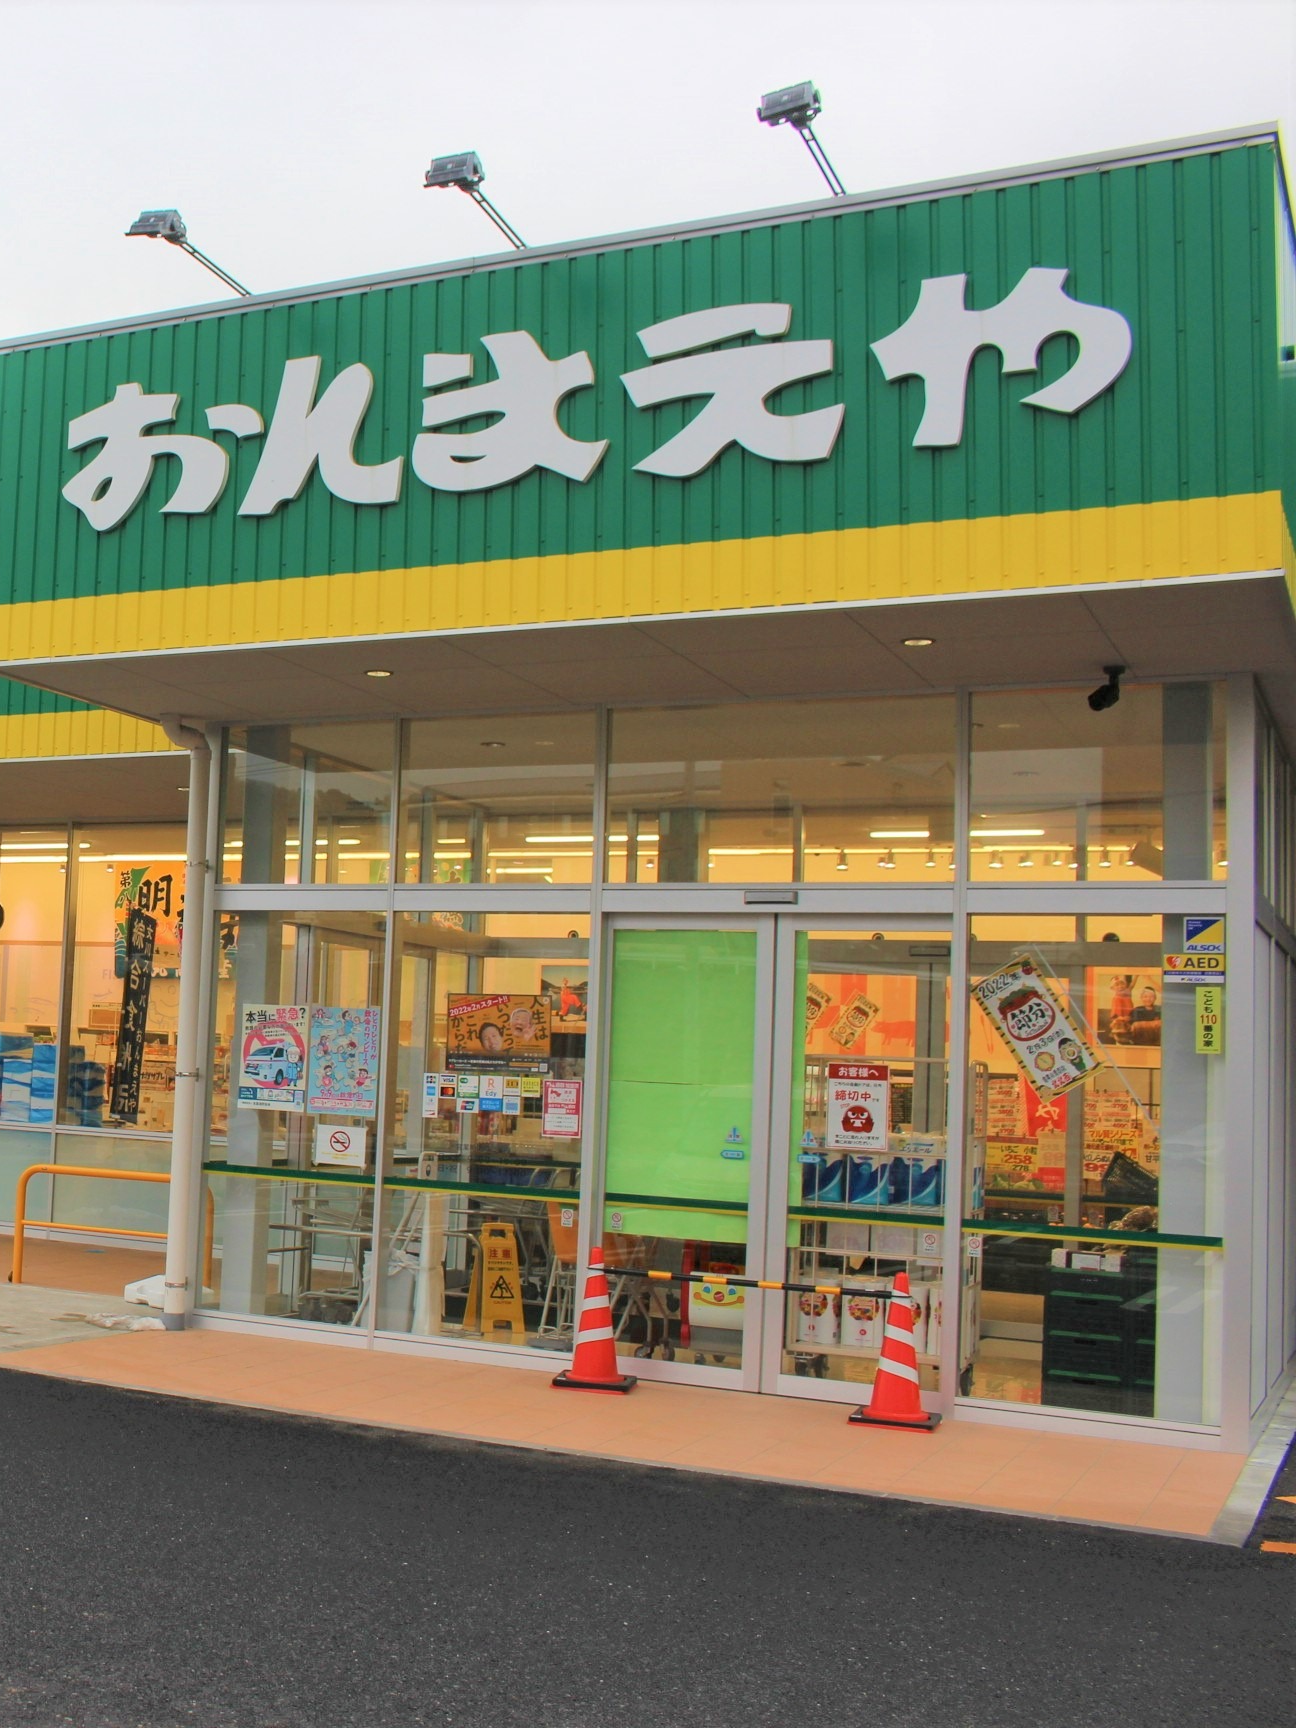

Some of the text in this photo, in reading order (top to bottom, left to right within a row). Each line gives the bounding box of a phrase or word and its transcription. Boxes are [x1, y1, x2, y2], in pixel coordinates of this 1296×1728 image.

[62, 267, 1133, 531] おんまえや
[1183, 957, 1219, 968] AED
[530, 996, 548, 1041] 人生は
[1011, 1003, 1046, 1031] 節分
[838, 1067, 879, 1077] お客様へ
[1004, 1154, 1032, 1165] 258
